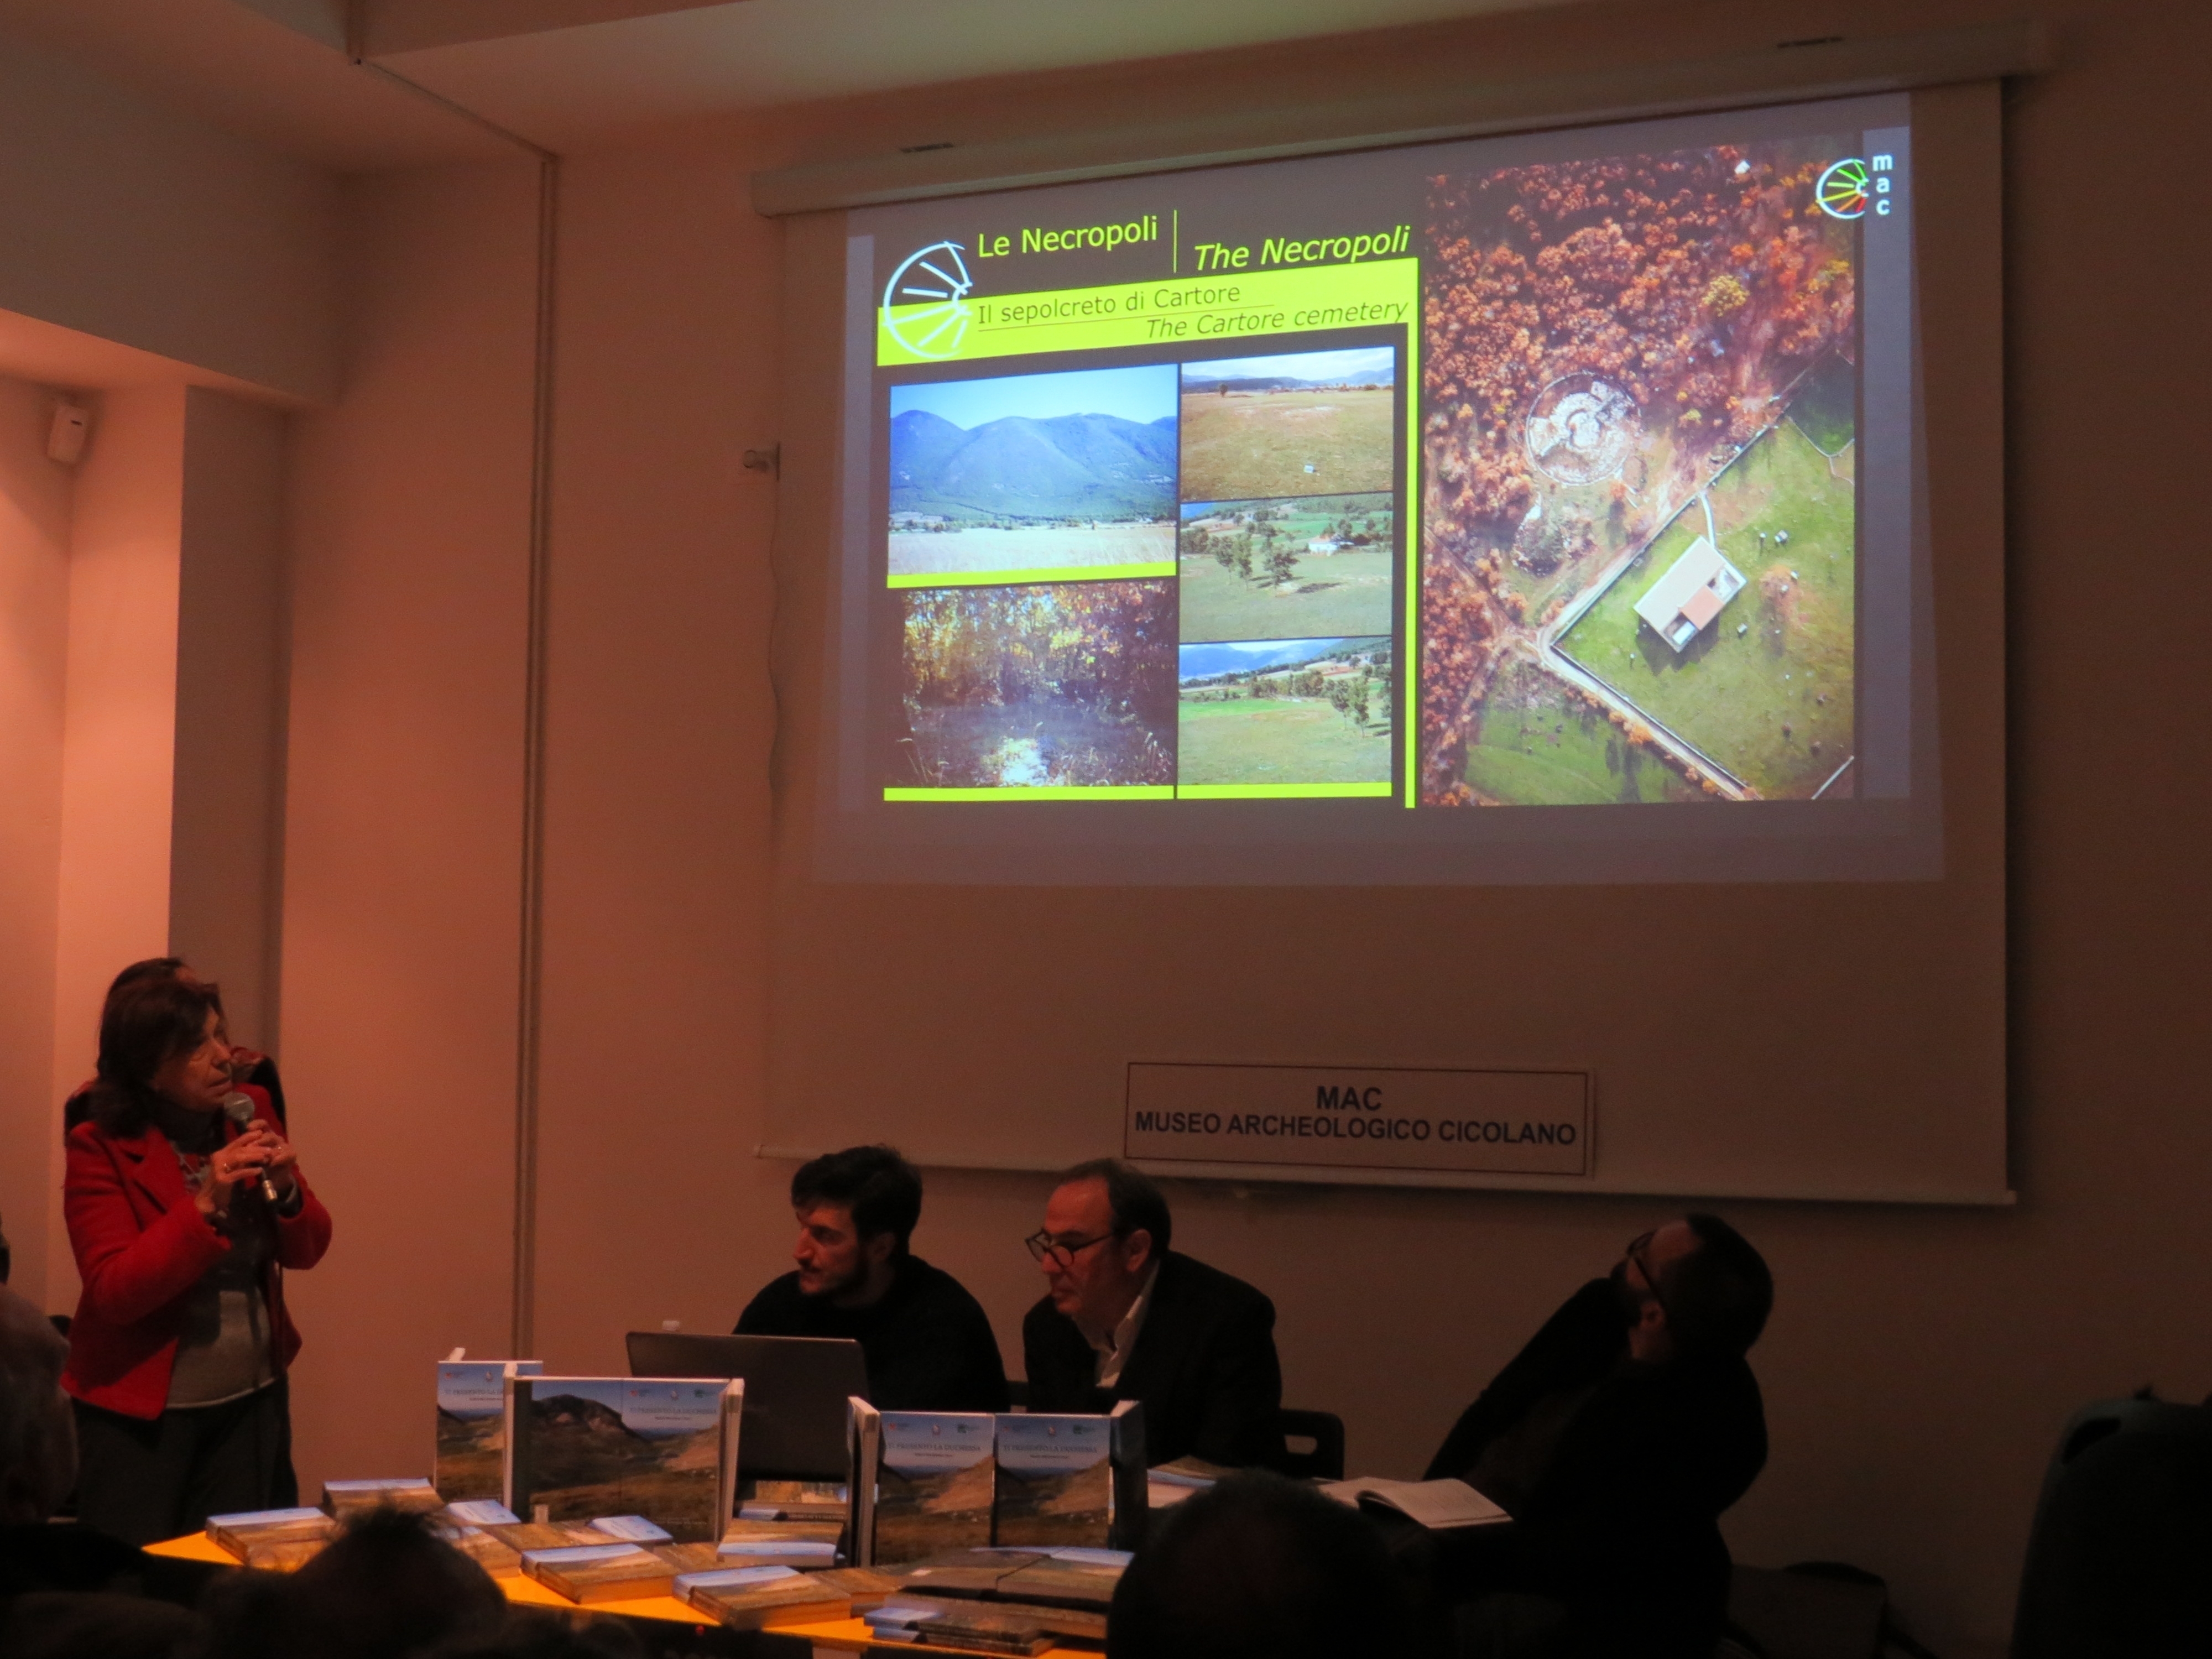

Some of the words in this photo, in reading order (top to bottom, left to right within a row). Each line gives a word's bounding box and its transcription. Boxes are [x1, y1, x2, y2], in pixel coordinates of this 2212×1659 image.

[978, 233, 1010, 258] Le
[1021, 216, 1158, 252] Necropoli
[1194, 243, 1249, 272] The
[1261, 226, 1410, 264] Necropoli
[978, 305, 993, 324] Il
[1001, 295, 1116, 325] sepolcreto
[1125, 291, 1145, 310] di
[1154, 285, 1241, 308] Cartore
[1146, 317, 1187, 339] The
[1197, 310, 1284, 333] Cartore
[1293, 299, 1409, 328] cemetery
[1316, 1086, 1383, 1110] MAC
[1135, 1112, 1220, 1134] MUSEO
[1227, 1114, 1431, 1141] ARCHEOLOGICO
[1438, 1120, 1576, 1145] CICOLANO
